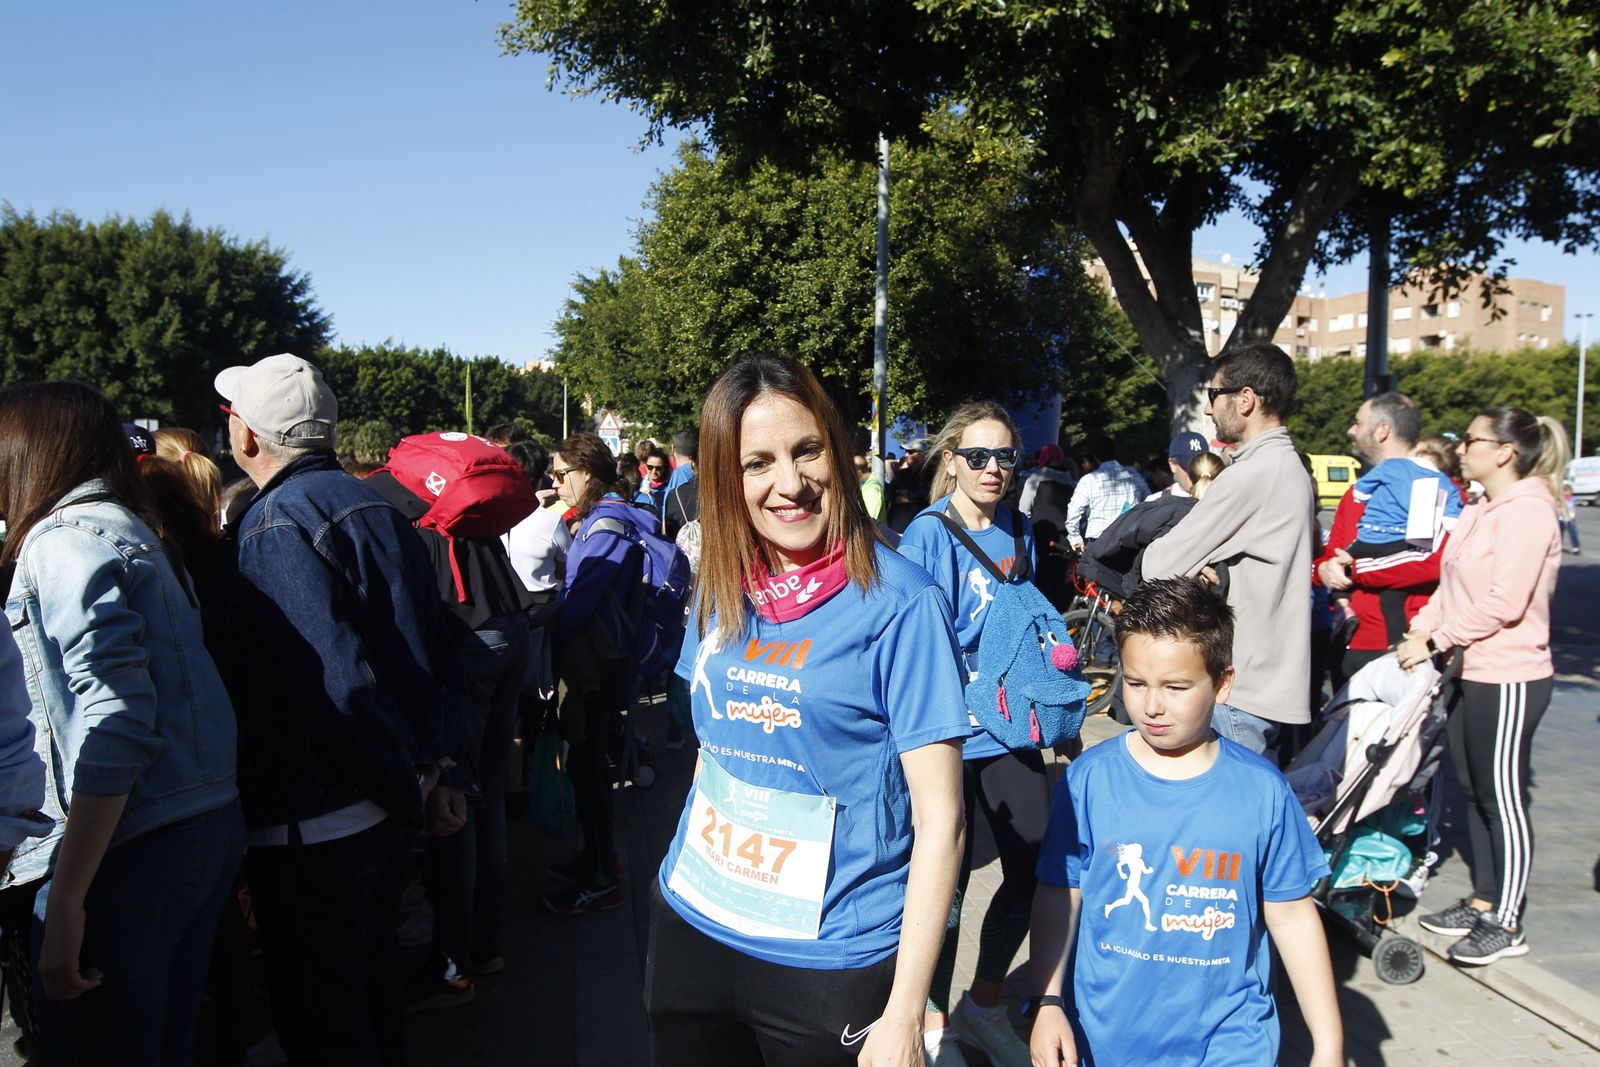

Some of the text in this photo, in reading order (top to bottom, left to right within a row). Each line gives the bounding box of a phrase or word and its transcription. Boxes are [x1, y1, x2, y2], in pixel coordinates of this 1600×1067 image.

[1190, 438, 1202, 451] NY
[743, 638, 813, 670] VIII
[726, 666, 802, 694] CARRERA
[726, 681, 800, 706] DE LA
[720, 747, 733, 757] ES
[733, 749, 776, 765] NUESTRA
[777, 757, 806, 773] META
[701, 806, 797, 874] 2147
[705, 844, 725, 867] MARI
[726, 861, 779, 885] CARMEN
[1170, 845, 1242, 881] VIII
[1165, 884, 1238, 901] CARRERA
[1165, 897, 1236, 910] DE LA
[1101, 942, 1112, 952] LA
[1152, 953, 1165, 962] ES
[1167, 955, 1211, 967] NUESTRA
[1211, 956, 1231, 966] META
